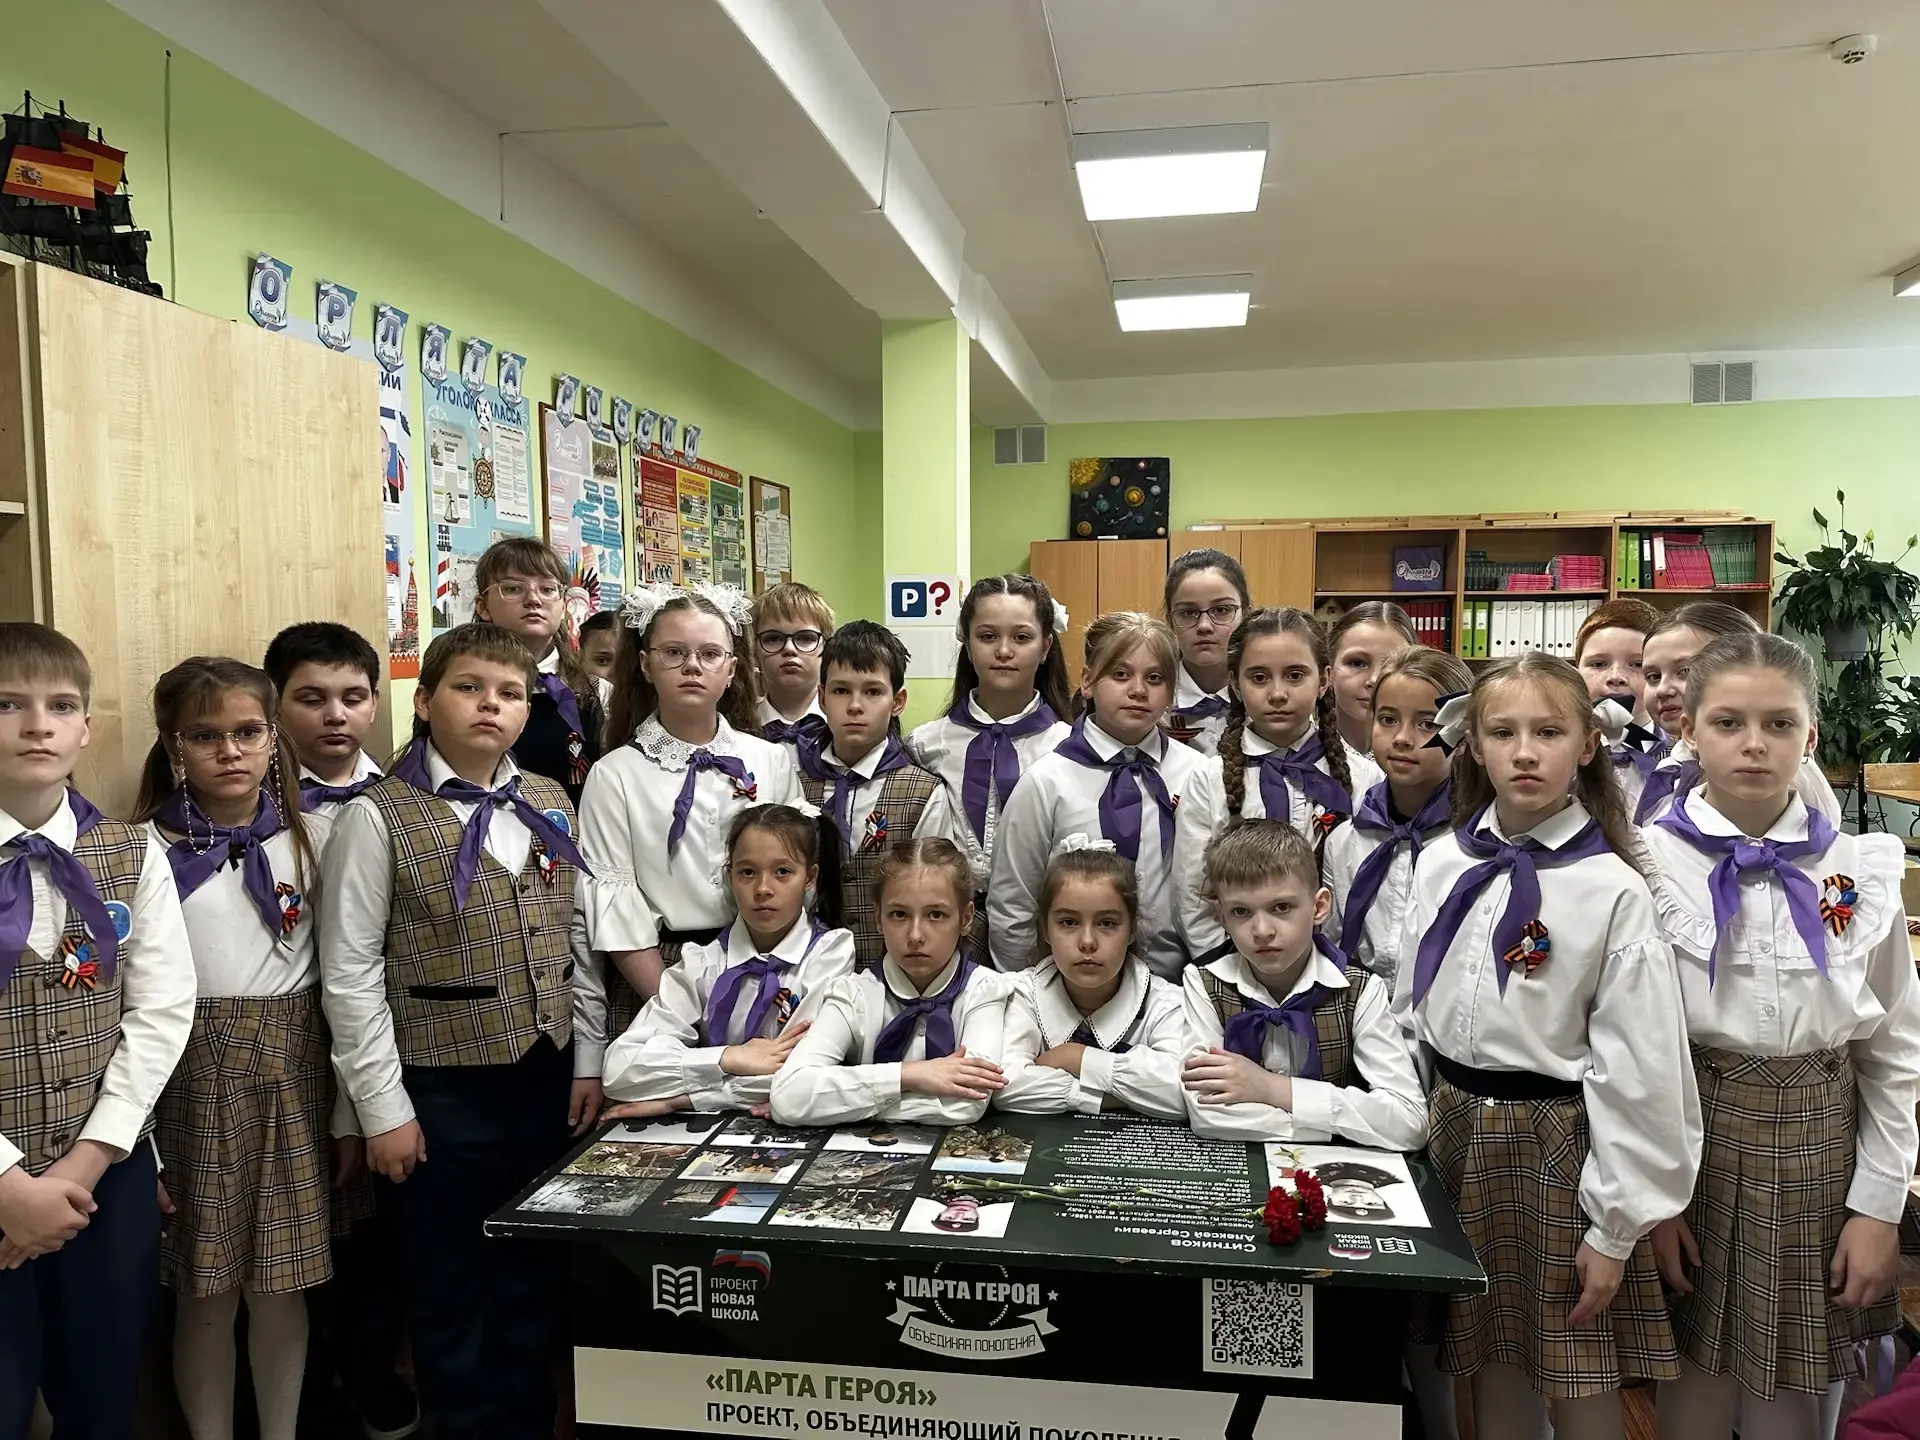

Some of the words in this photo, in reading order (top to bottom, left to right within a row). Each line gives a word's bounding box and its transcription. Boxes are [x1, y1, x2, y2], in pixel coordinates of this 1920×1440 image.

[1114, 1227, 1190, 1238] Сергеевич
[1194, 1231, 1256, 1243] Алексей
[1171, 1239, 1256, 1253] Ситников
[711, 1277, 758, 1291] ПРОЕКТ
[903, 1275, 971, 1301] ПАРТА
[975, 1281, 1041, 1306] ГЕРОЯ
[711, 1292, 755, 1306] НОВАЯ
[711, 1306, 759, 1322] ШКОЛА
[908, 1325, 972, 1352] ОБЪЕДИНЯЯ
[975, 1333, 1036, 1352] ПОКОЛЕНИЯ
[706, 1367, 818, 1400] «ПАРТА
[825, 1375, 937, 1406] ГЕРОЯ»
[706, 1402, 799, 1432] ПРОЕКТ,
[806, 1408, 1021, 1440] ОБЪЕДИНЯЮЩИЙ
